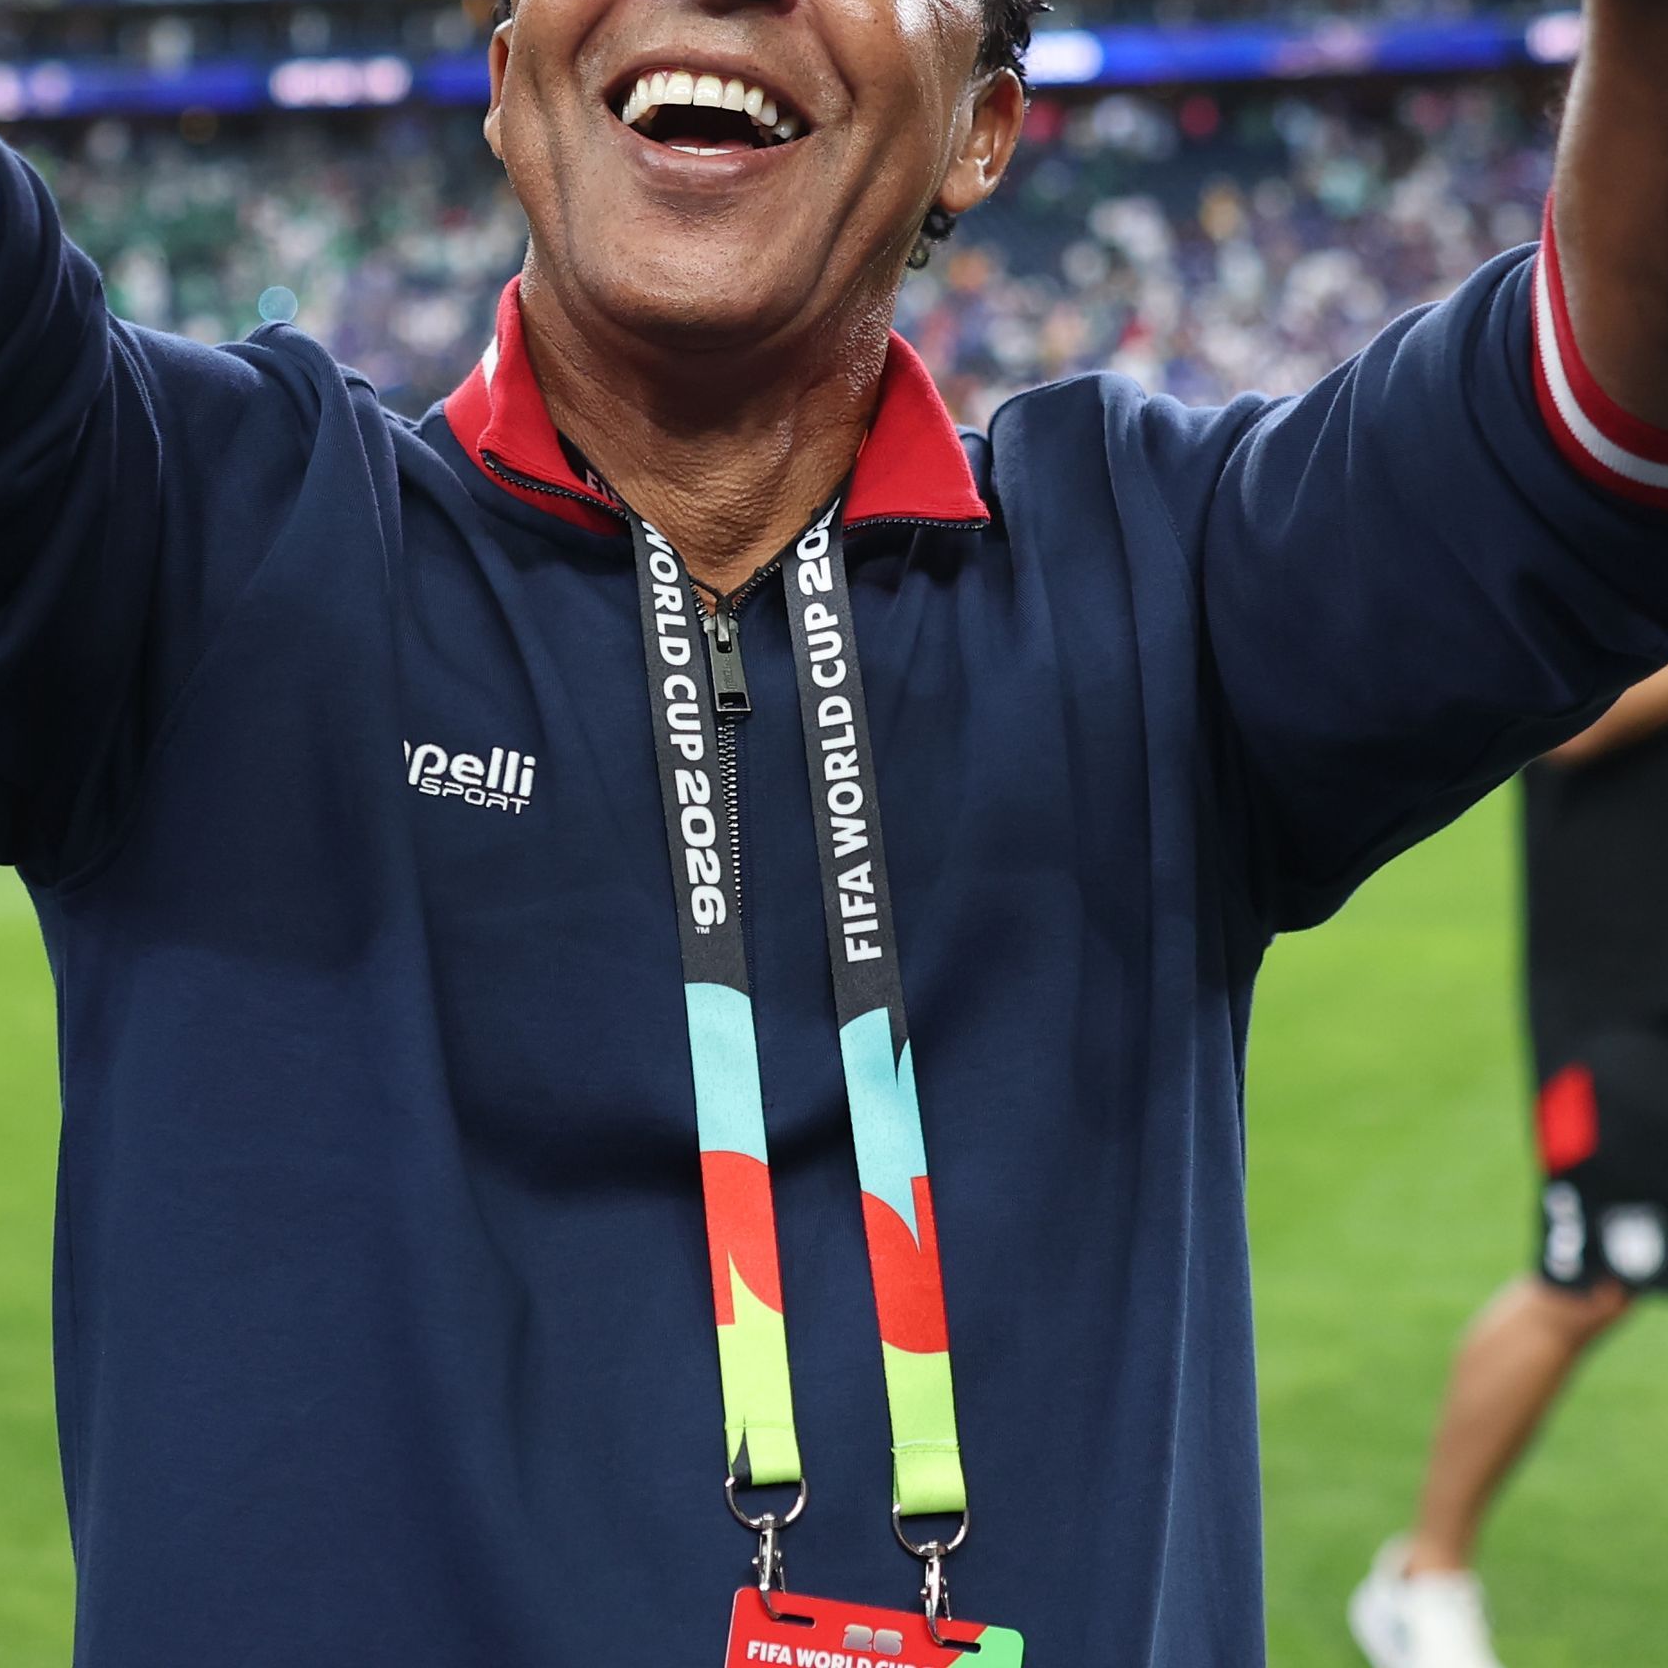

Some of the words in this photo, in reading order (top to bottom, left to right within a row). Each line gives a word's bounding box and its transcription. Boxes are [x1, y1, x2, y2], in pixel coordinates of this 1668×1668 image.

[796, 497, 841, 596] 202
[641, 520, 692, 666] WORLD
[803, 602, 847, 689] CUP
[663, 674, 704, 761] CUP
[403, 739, 536, 798] pelli
[418, 777, 531, 814] SPORT
[818, 694, 869, 859] WORLD
[674, 769, 726, 926] 2026
[837, 860, 883, 963] FIFA
[746, 1639, 793, 1666] FIFA
[842, 1623, 903, 1656] 26
